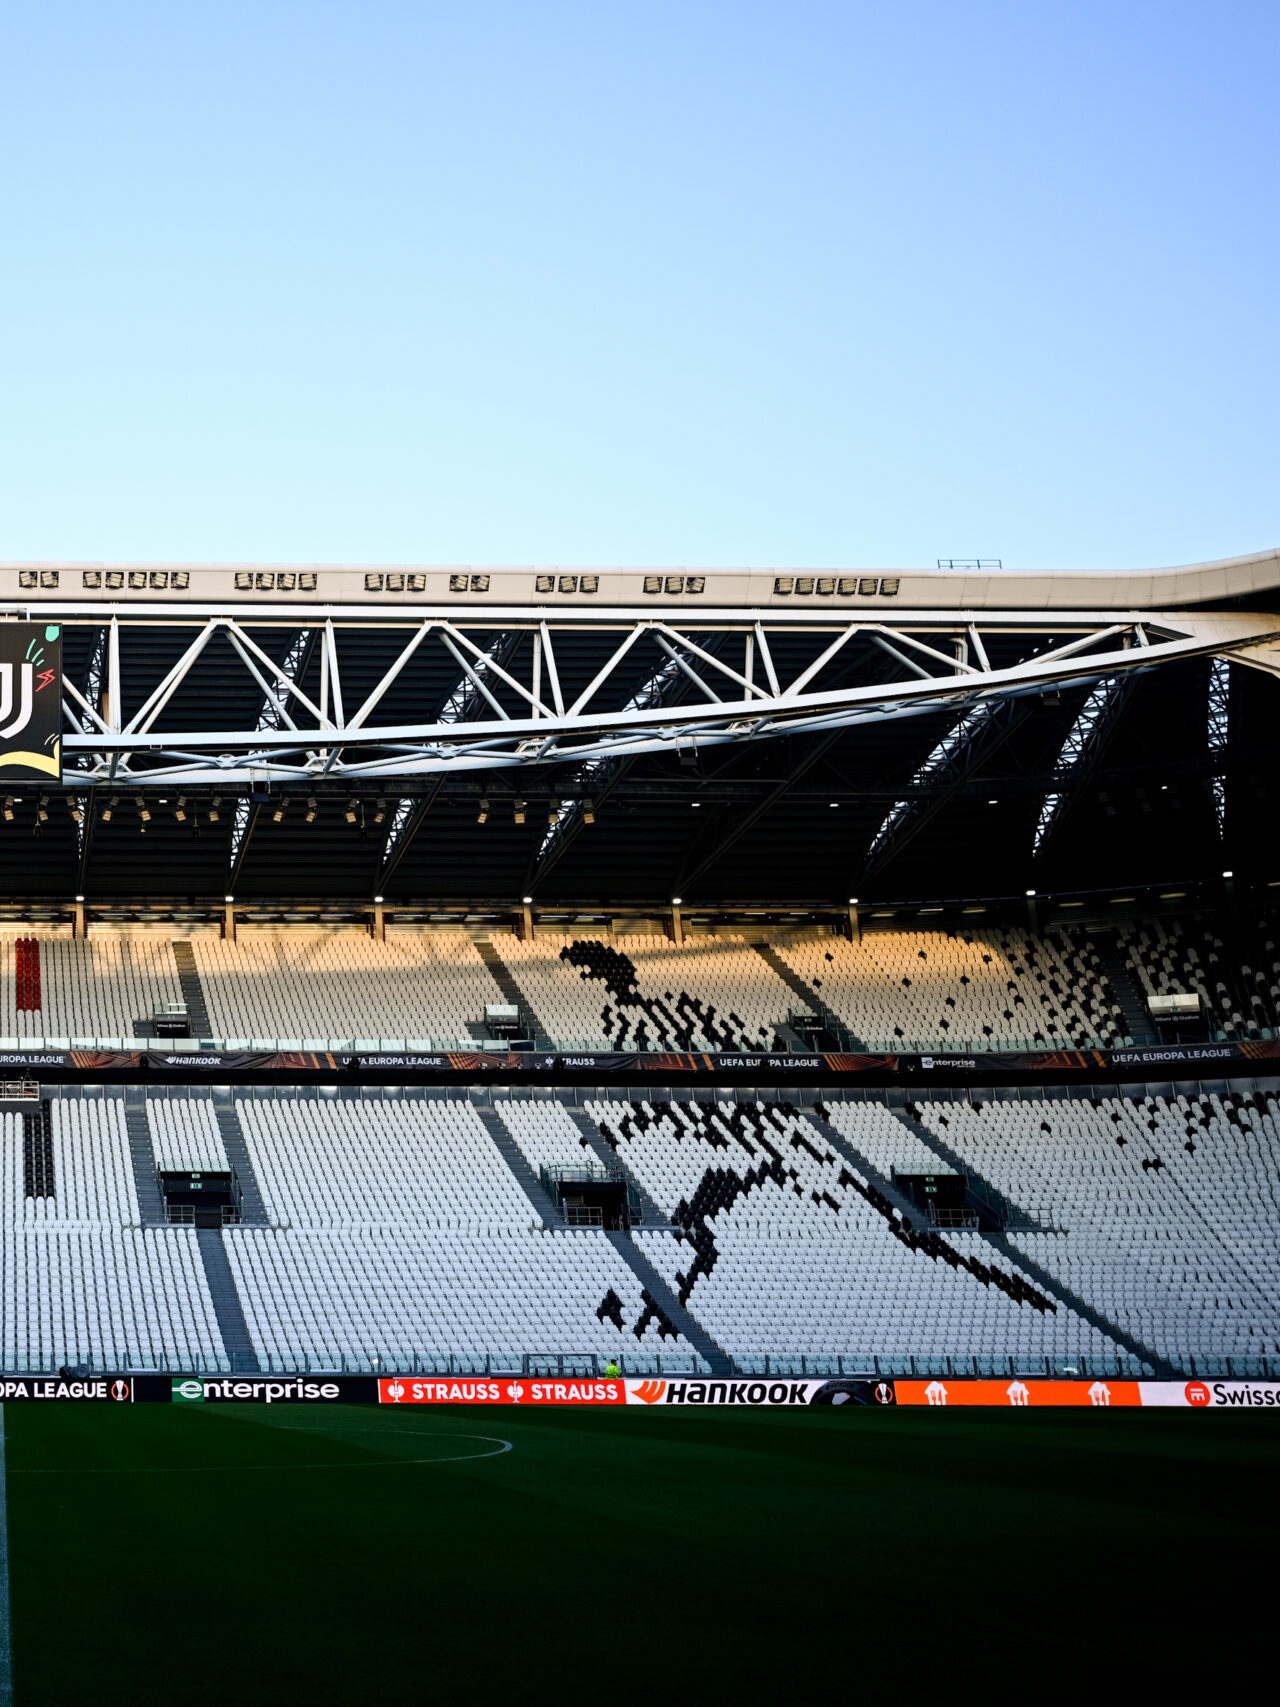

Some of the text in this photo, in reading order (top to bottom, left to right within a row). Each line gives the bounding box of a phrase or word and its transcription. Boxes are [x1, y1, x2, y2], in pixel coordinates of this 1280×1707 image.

[28, 1056, 64, 1064] LEAGUE
[369, 1057, 404, 1065] EUROPA
[406, 1057, 442, 1065] LEAGUE
[719, 1058, 744, 1067] UEFA
[783, 1059, 819, 1067] LEAGUE
[923, 1058, 976, 1067] enterprise
[1112, 1048, 1231, 1063] UEFA EUROPA LEAGUE
[33, 1382, 107, 1398] LEAGUE
[172, 1378, 340, 1403] enterprise
[412, 1383, 500, 1400] STRAUSS
[531, 1384, 618, 1400] STRAUSS
